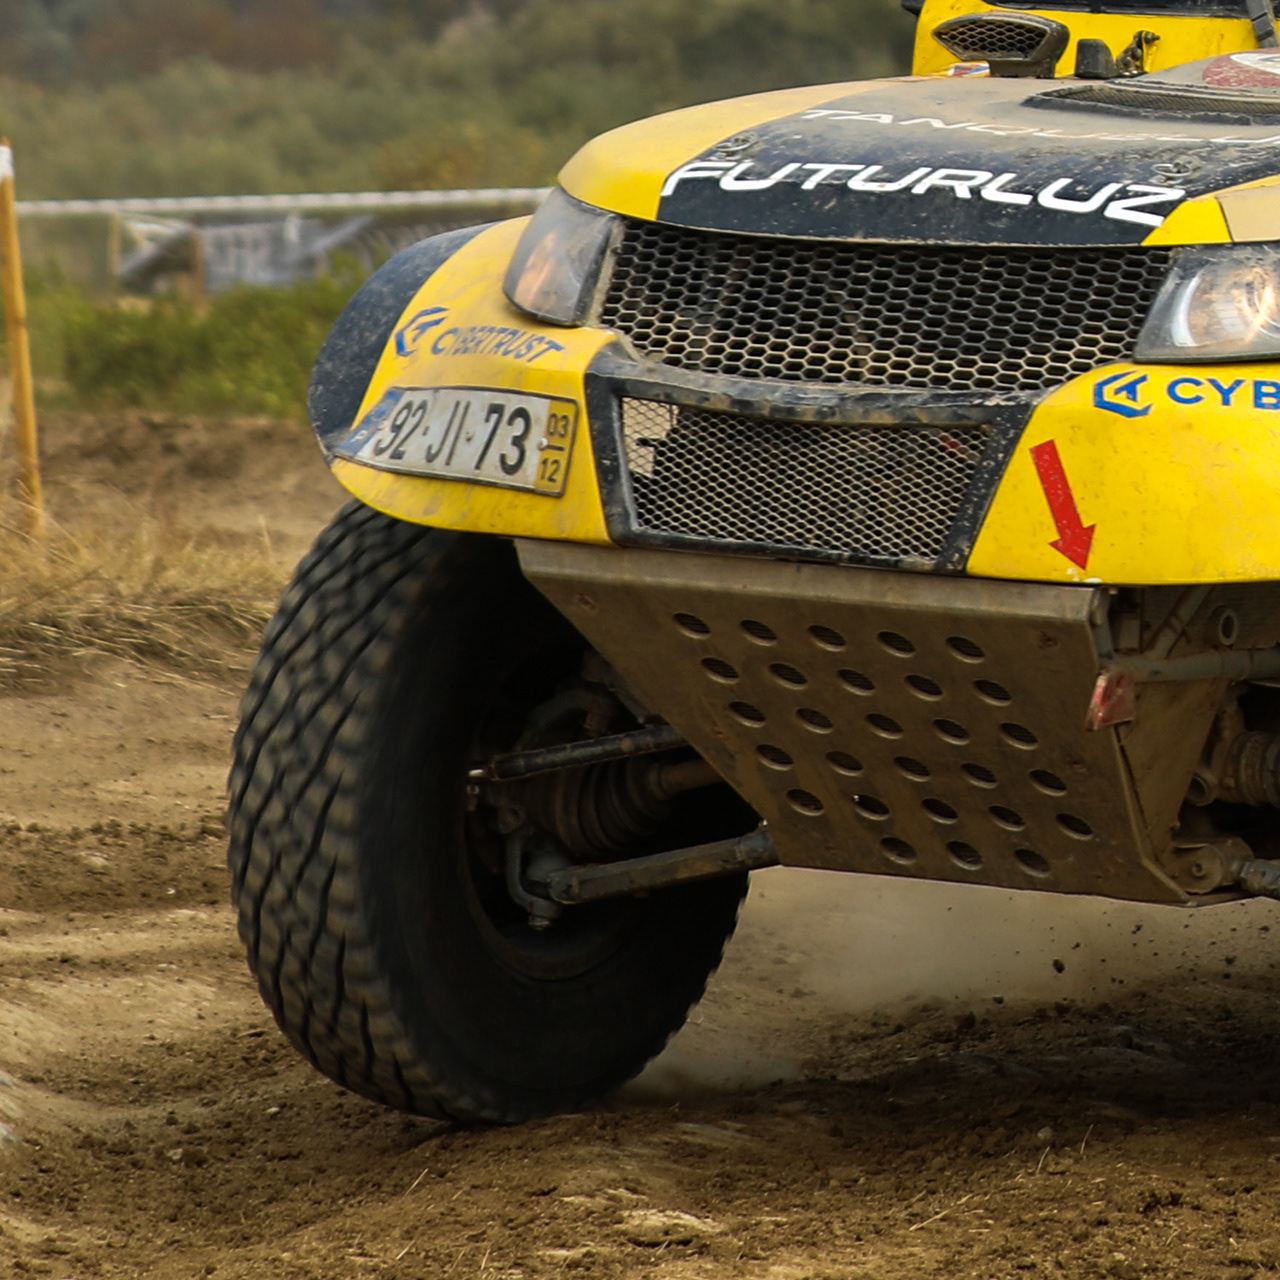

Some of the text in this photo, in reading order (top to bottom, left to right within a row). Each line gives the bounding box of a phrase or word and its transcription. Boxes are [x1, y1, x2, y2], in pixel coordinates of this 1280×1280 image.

[660, 159, 1187, 227] FUTURLUZ
[431, 326, 565, 363] CYBERTRUST
[547, 412, 570, 438] 03
[541, 459, 560, 483] 12
